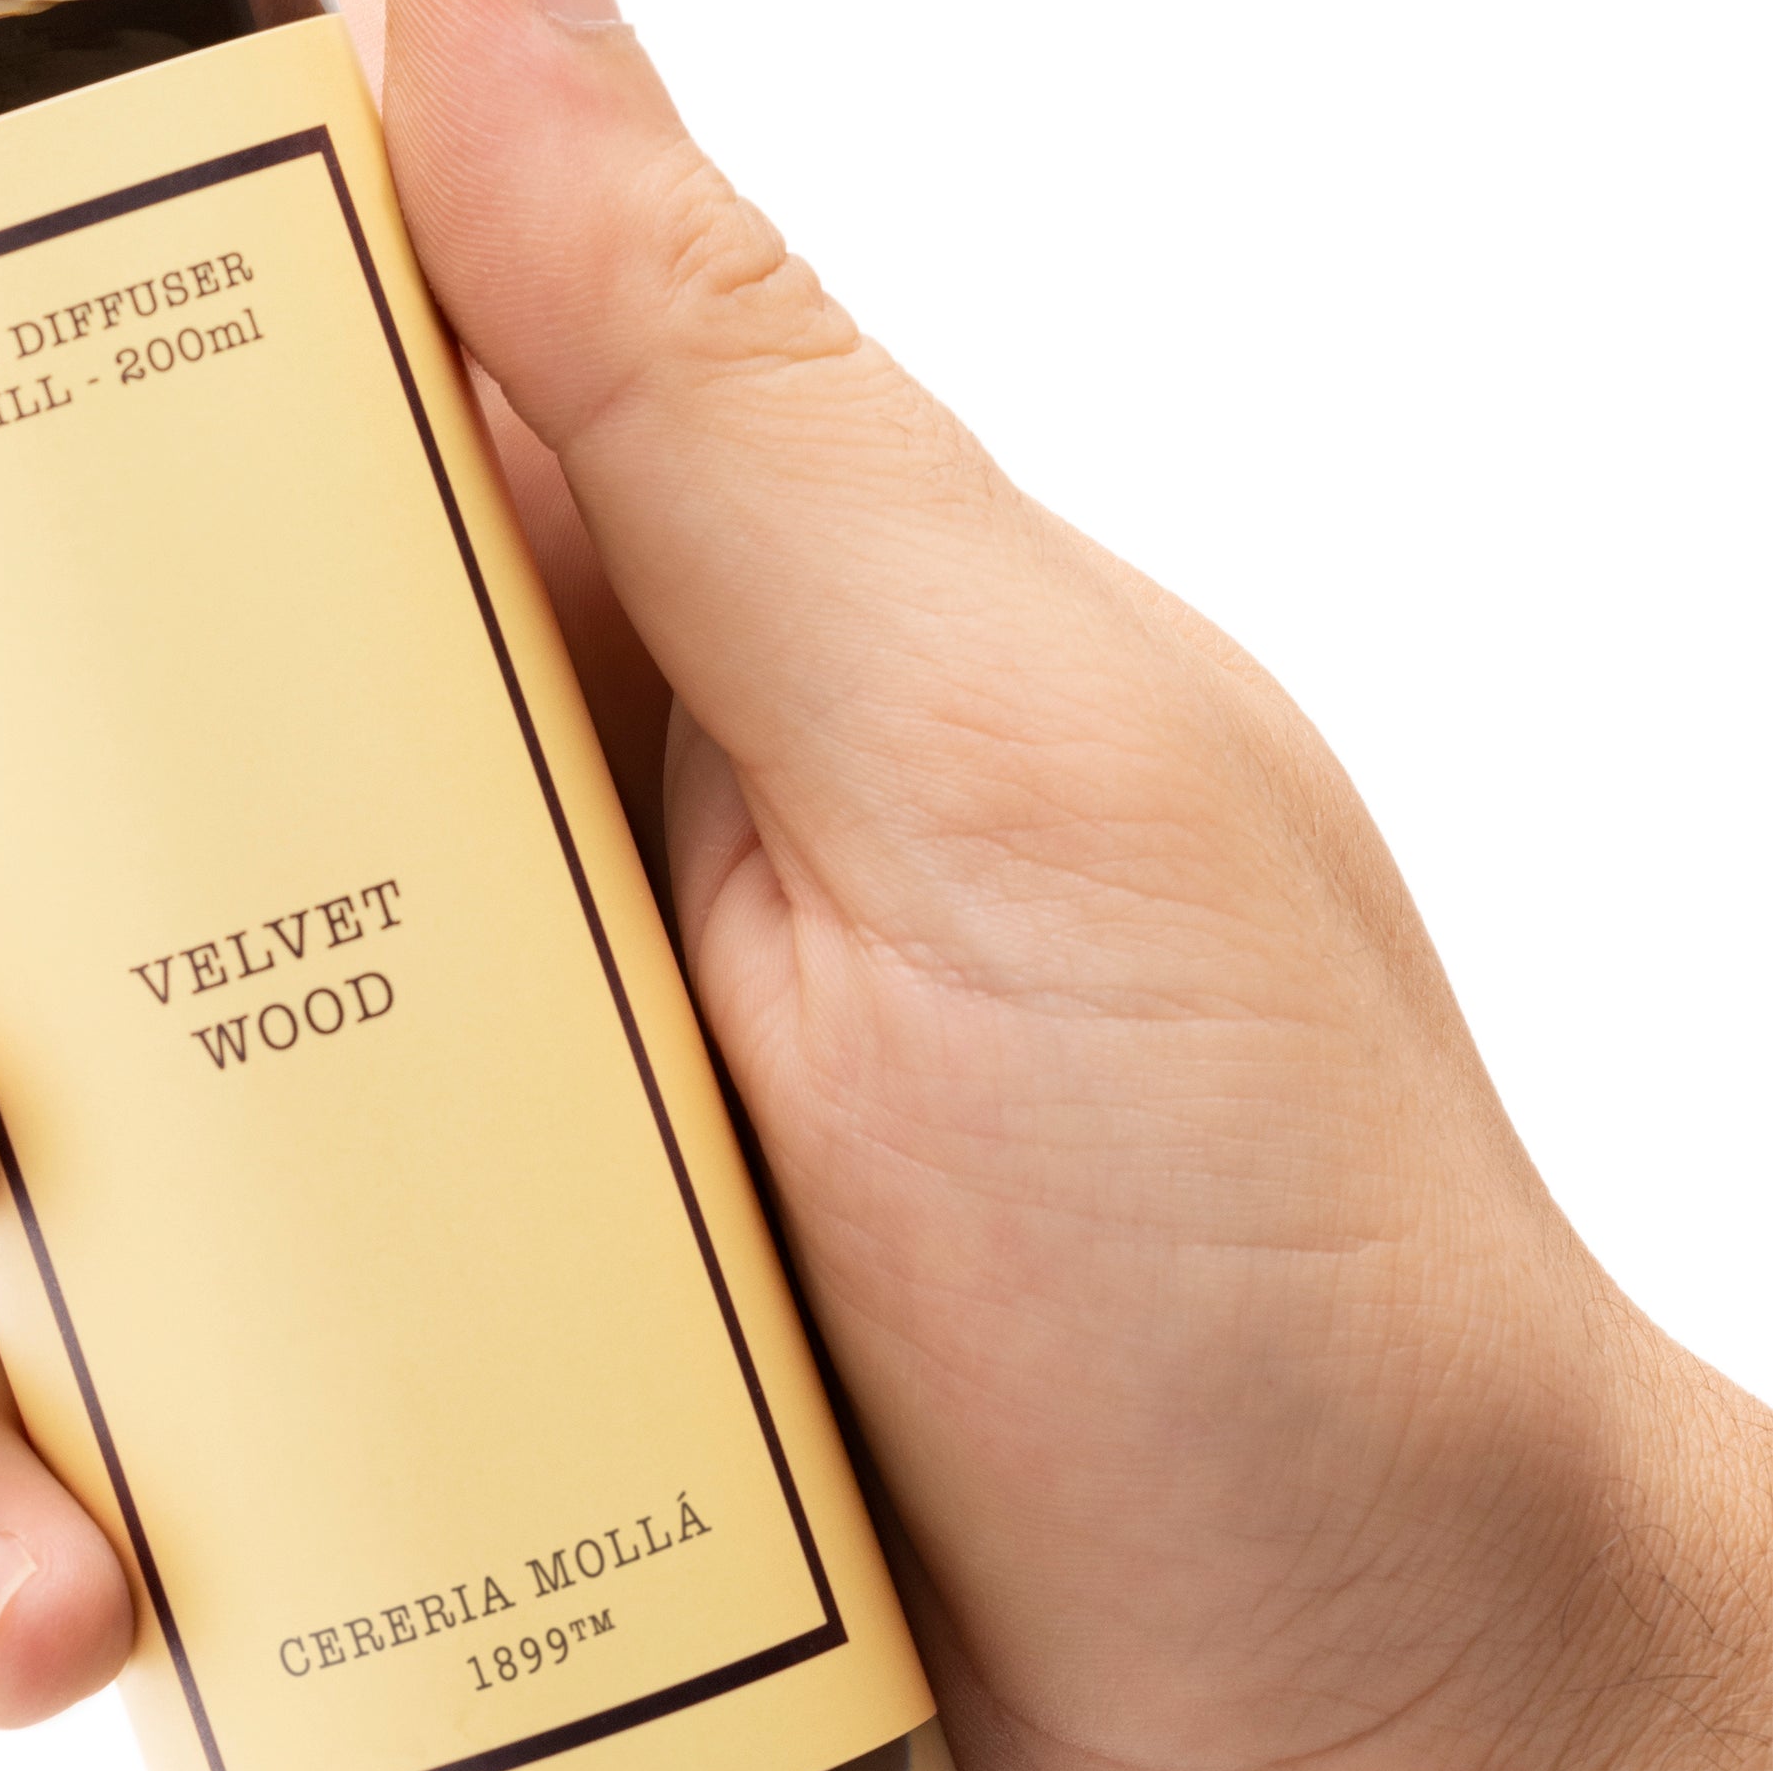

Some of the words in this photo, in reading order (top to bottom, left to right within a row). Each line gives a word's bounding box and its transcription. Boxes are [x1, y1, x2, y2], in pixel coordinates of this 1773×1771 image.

[7, 251, 255, 359] DIFFUSER
[114, 307, 265, 386] 200ml
[129, 879, 402, 1005] VELVET
[191, 971, 395, 1070] WOOD
[279, 1574, 515, 1678] CERERIA
[524, 1490, 712, 1598] MOLLÁ
